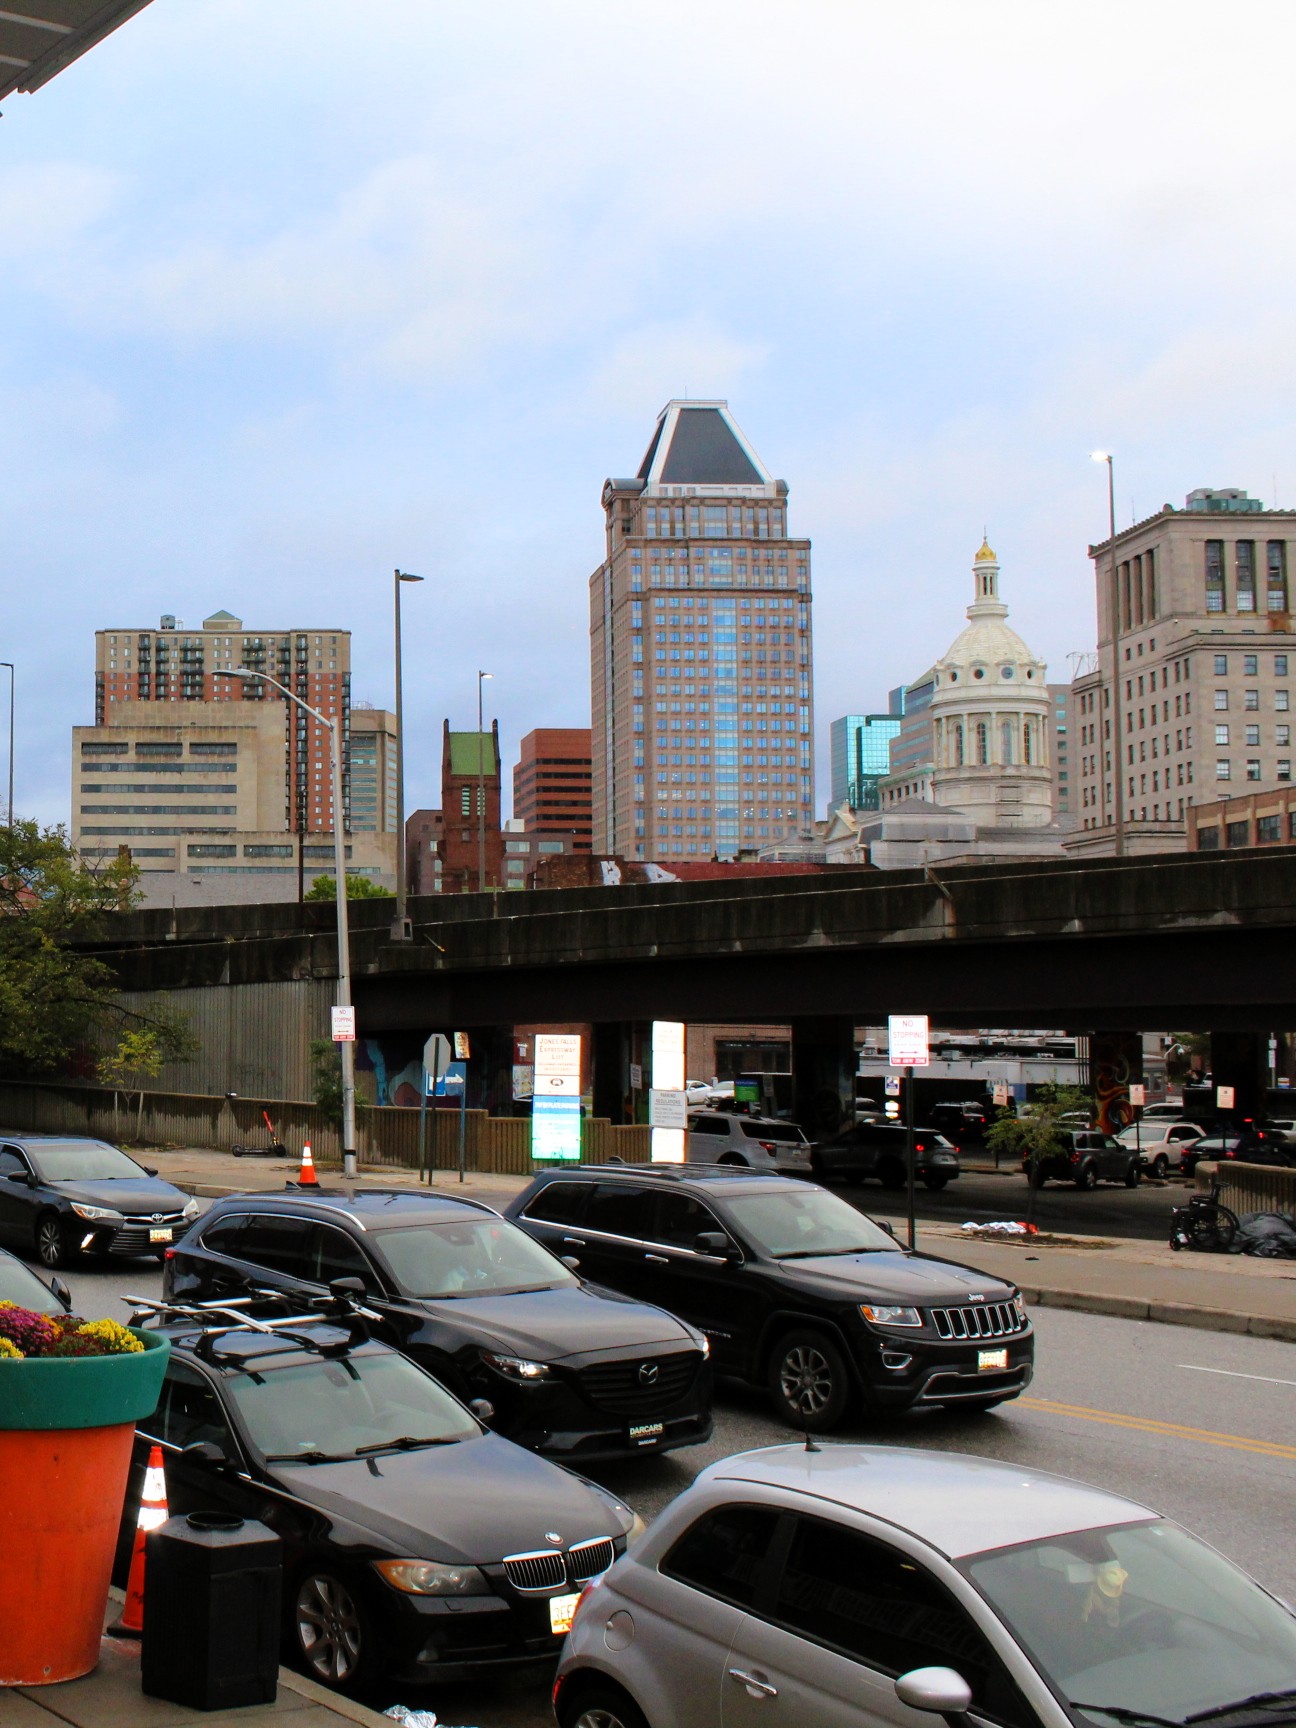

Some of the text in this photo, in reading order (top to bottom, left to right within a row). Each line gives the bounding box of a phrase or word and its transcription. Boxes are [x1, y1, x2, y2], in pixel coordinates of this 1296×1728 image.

[902, 1019, 914, 1028] NO
[893, 1031, 924, 1039] STOPPING
[968, 1293, 985, 1301] Jeep
[629, 1423, 663, 1436] DARCARS
